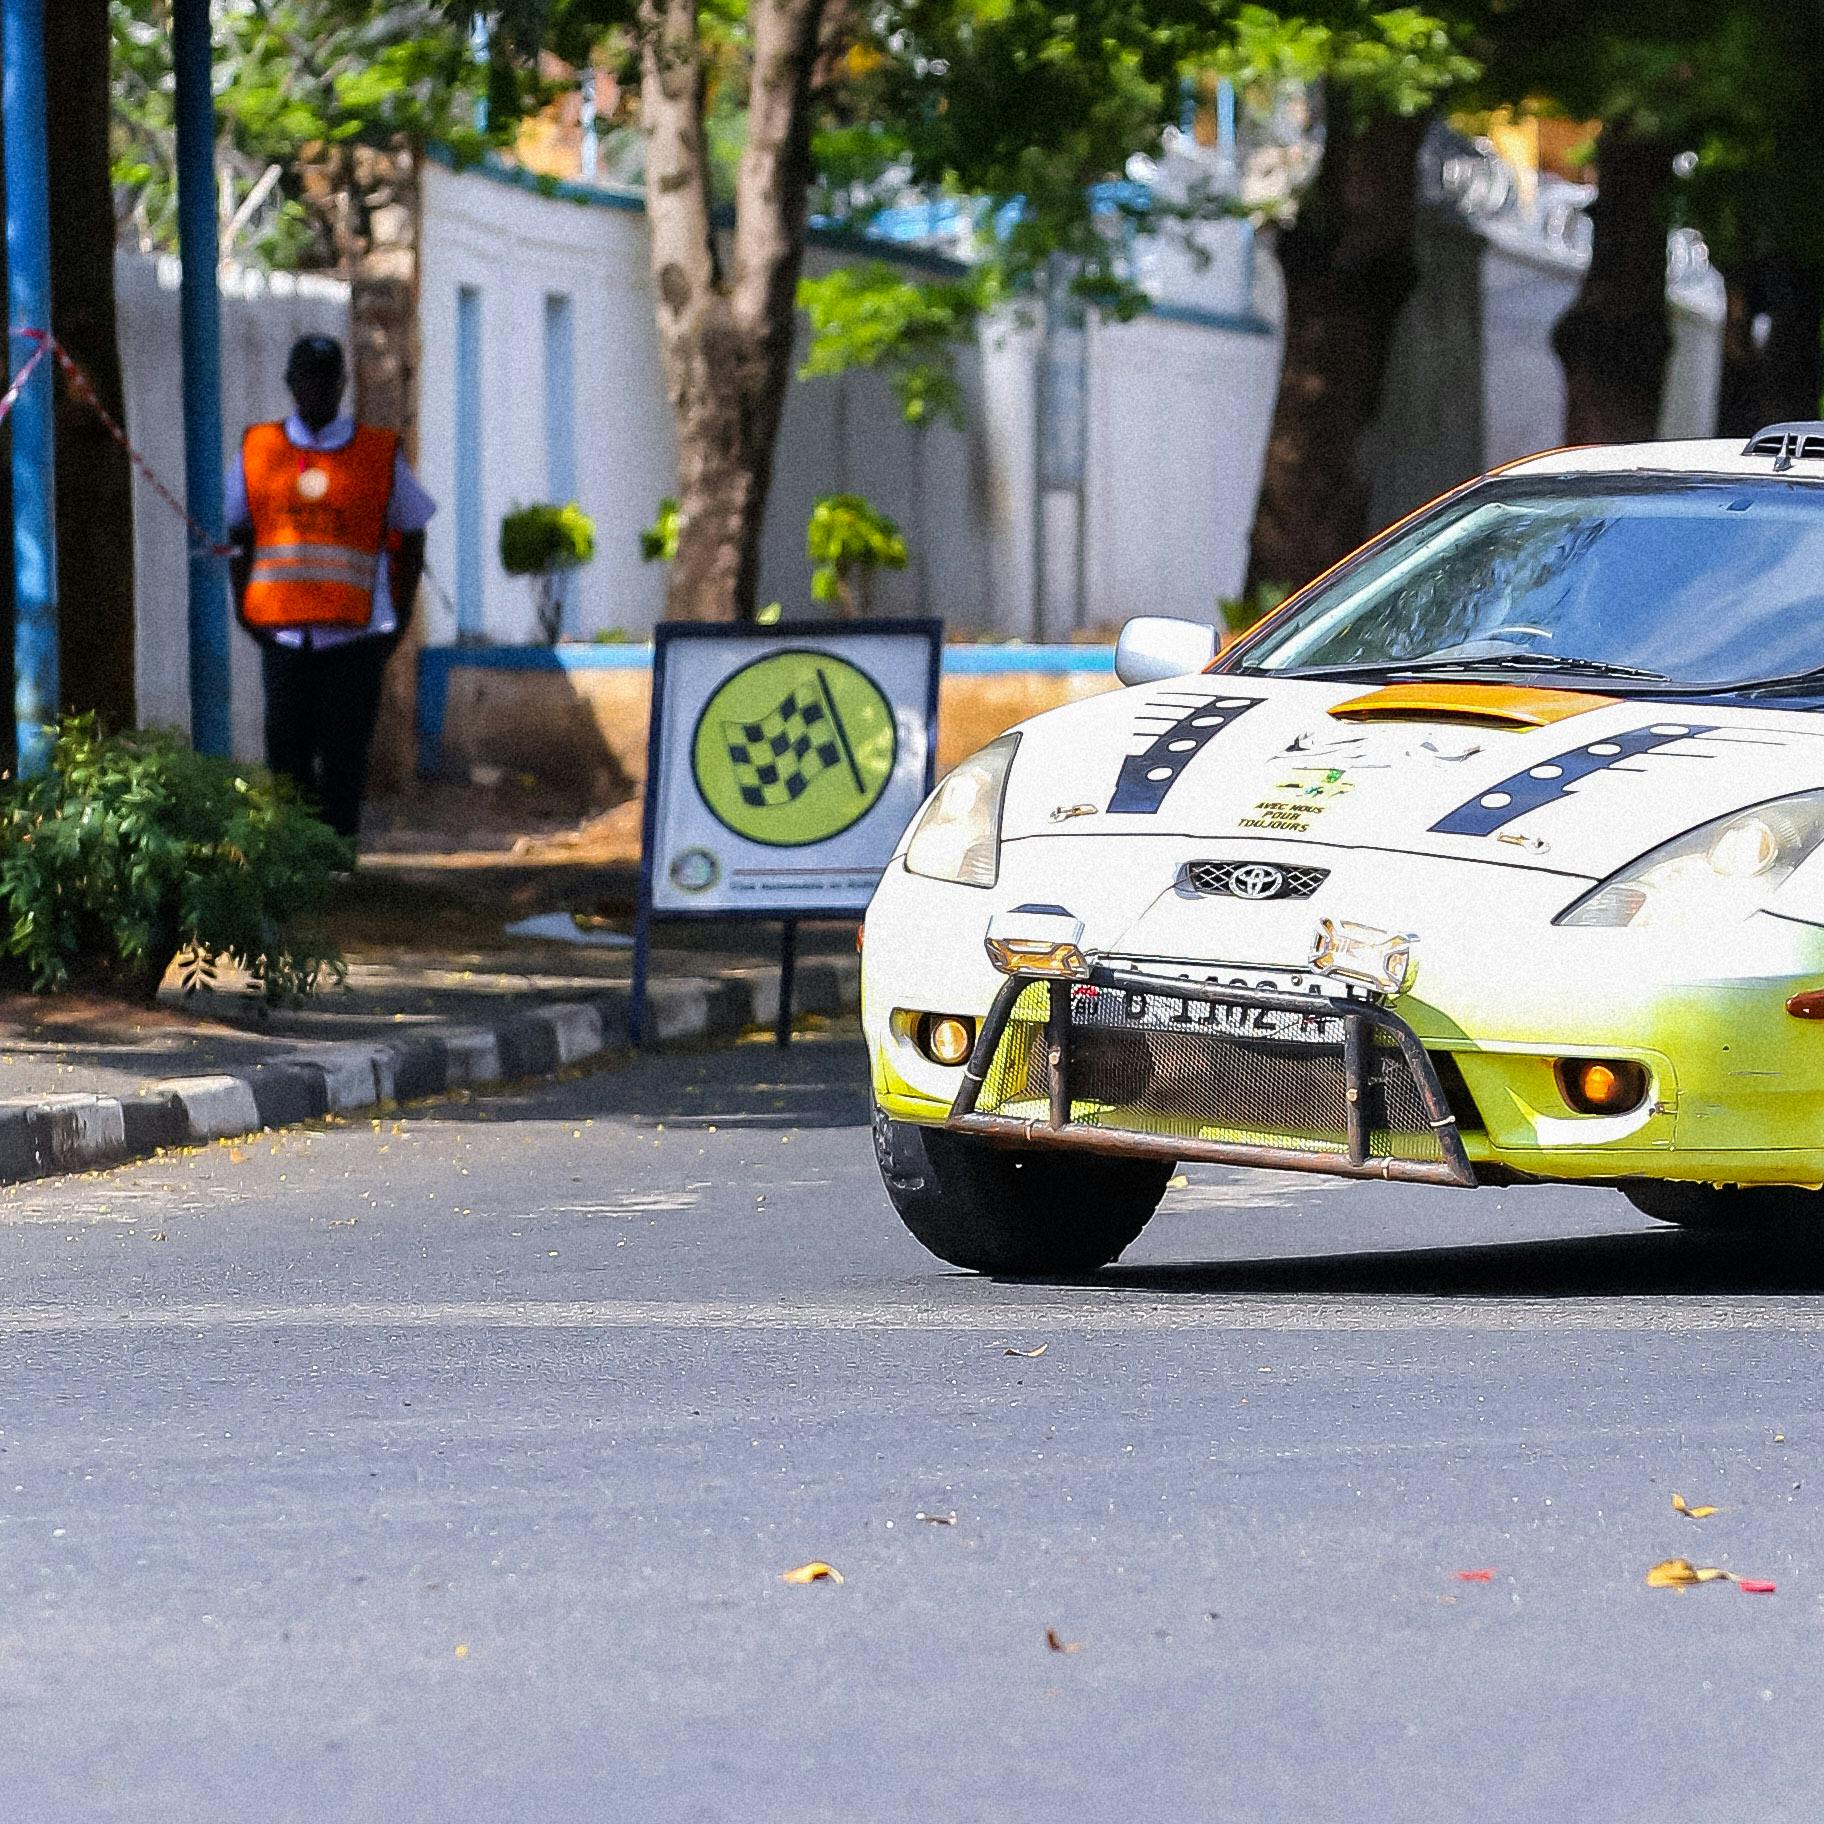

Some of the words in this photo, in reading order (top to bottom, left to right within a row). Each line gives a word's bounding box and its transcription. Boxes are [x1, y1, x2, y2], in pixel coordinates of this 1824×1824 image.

[1254, 802, 1289, 810] AVEC
[1289, 804, 1325, 814] NOUS
[1262, 811, 1301, 821] POUR
[1238, 818, 1309, 832] TOUJOURS
